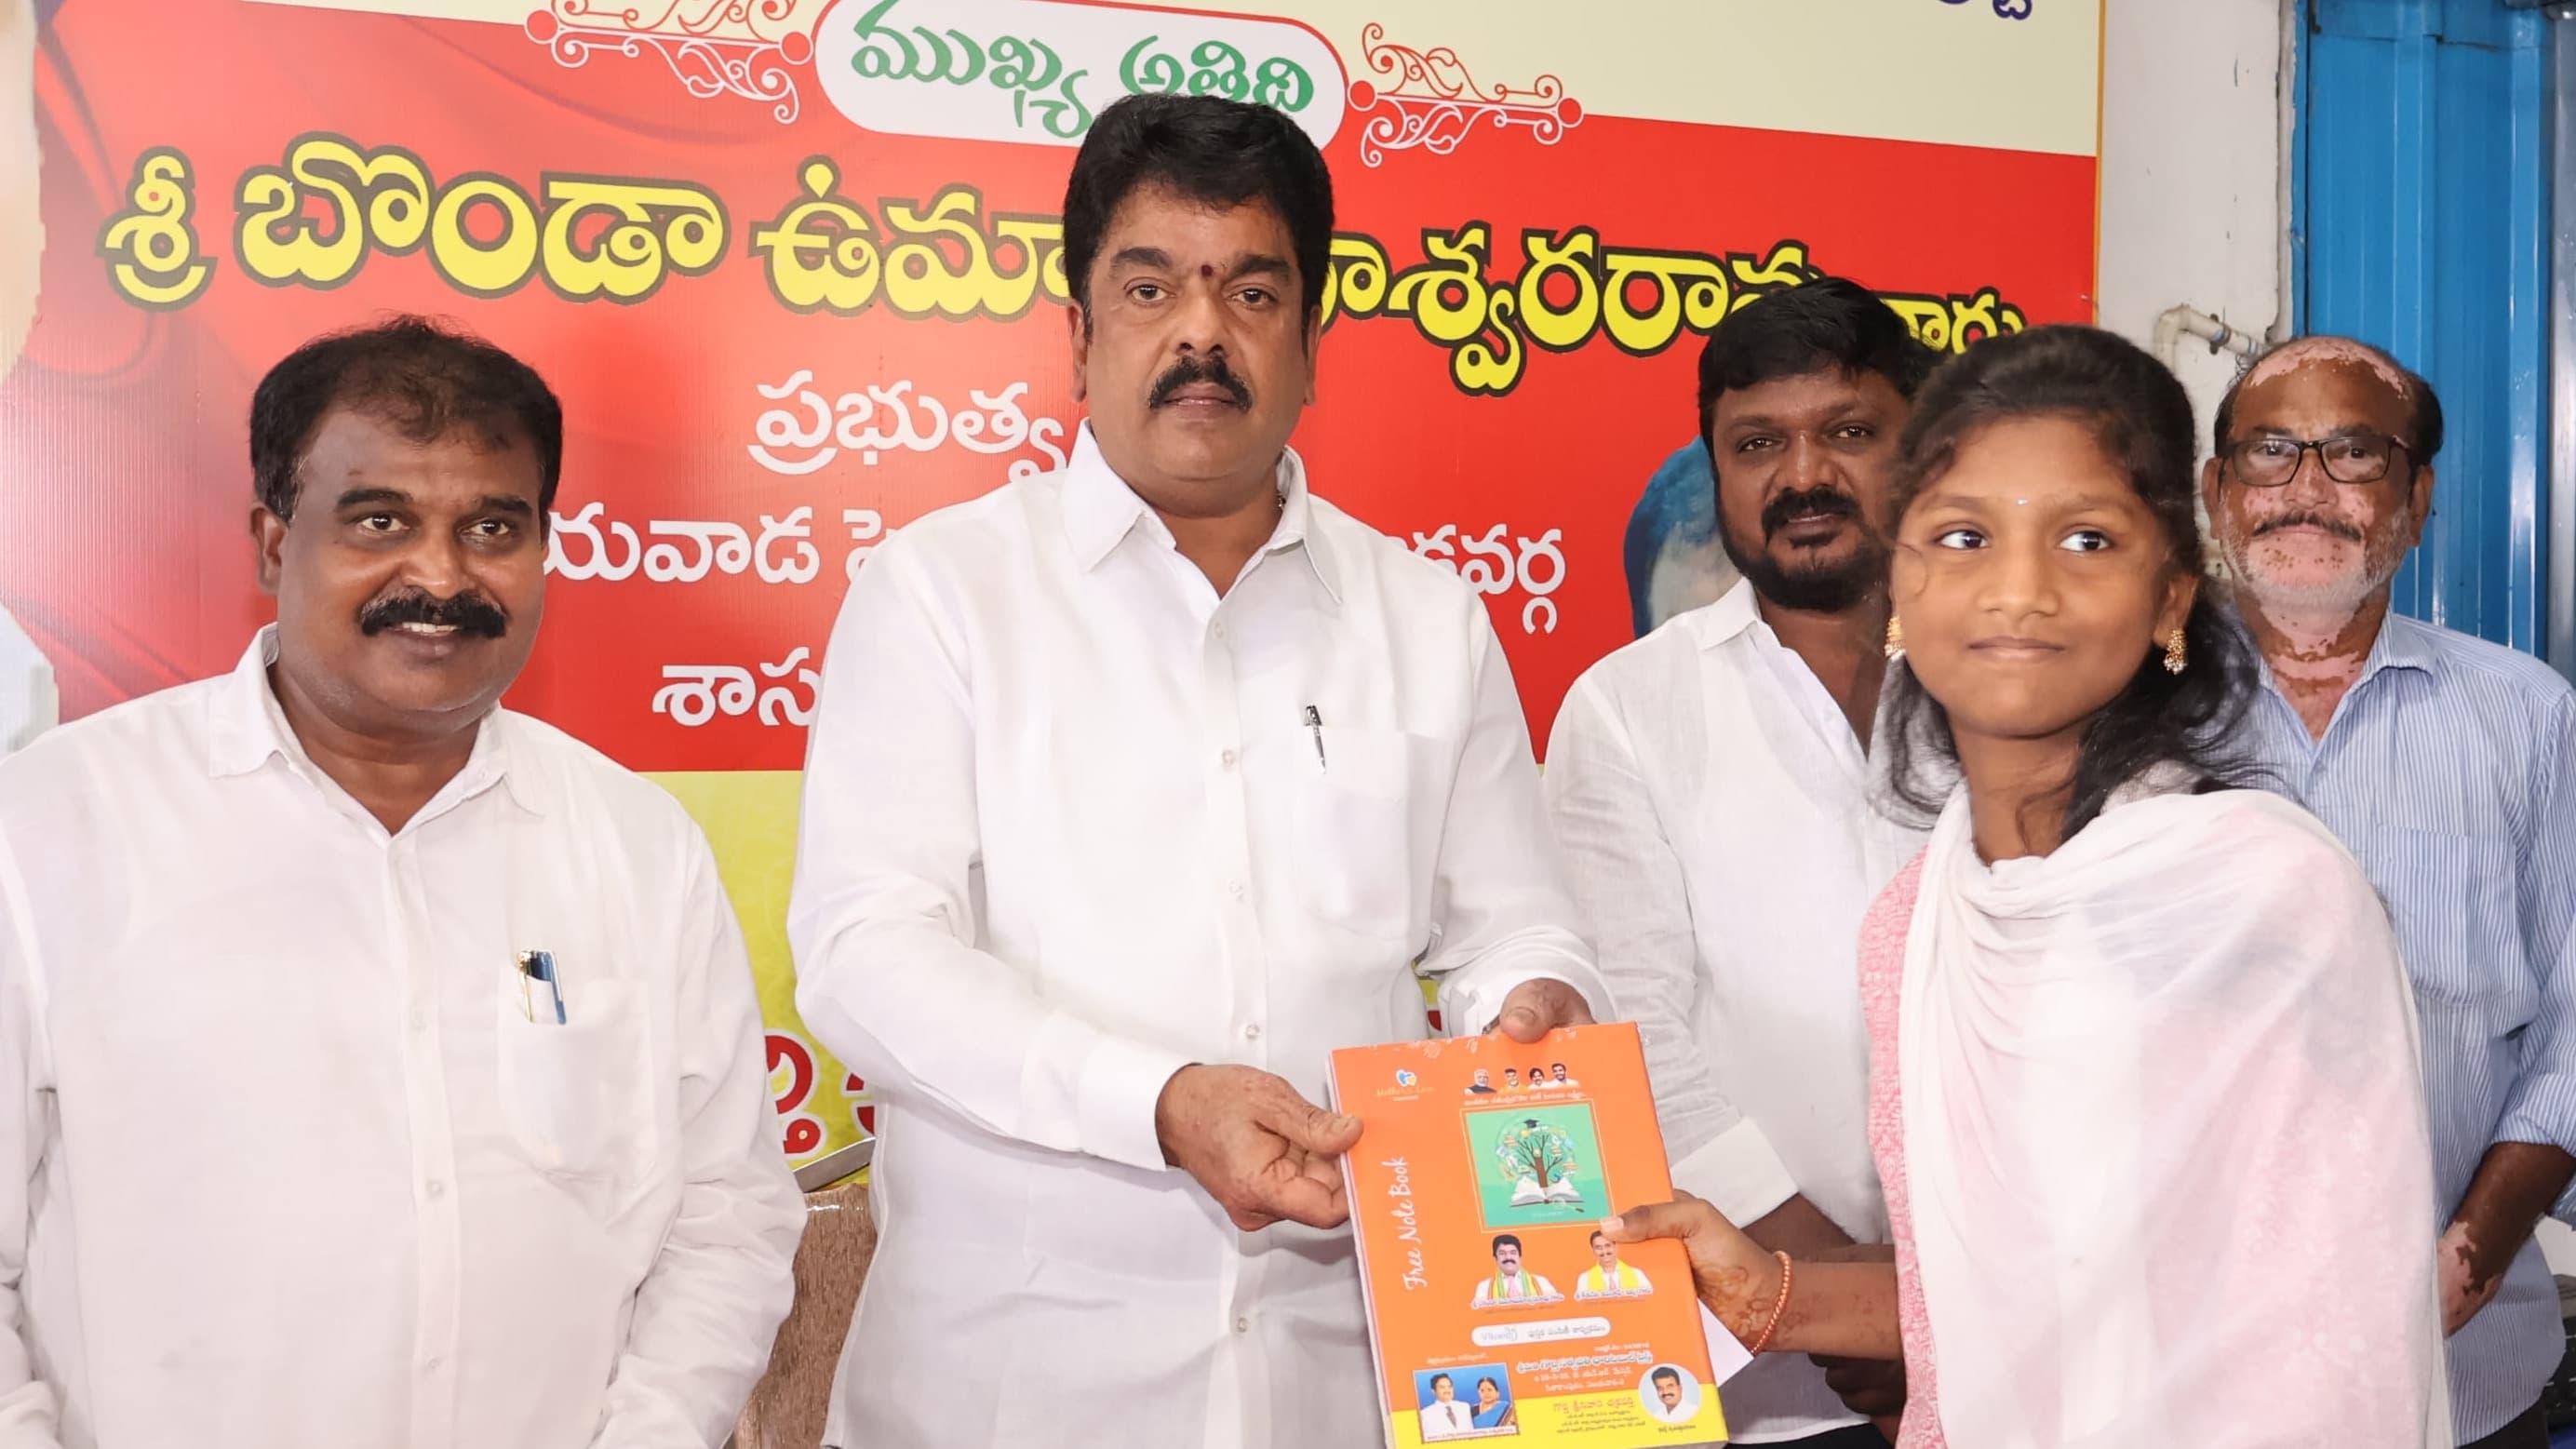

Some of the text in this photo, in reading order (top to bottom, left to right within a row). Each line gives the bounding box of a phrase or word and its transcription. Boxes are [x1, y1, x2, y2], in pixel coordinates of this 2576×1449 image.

[851, 0, 1093, 139] ముఖ్య
[100, 149, 215, 309] శ్రీ
[747, 369, 1067, 483] ప్రభుత్వ
[1381, 1157, 1428, 1290] Free Note Book
